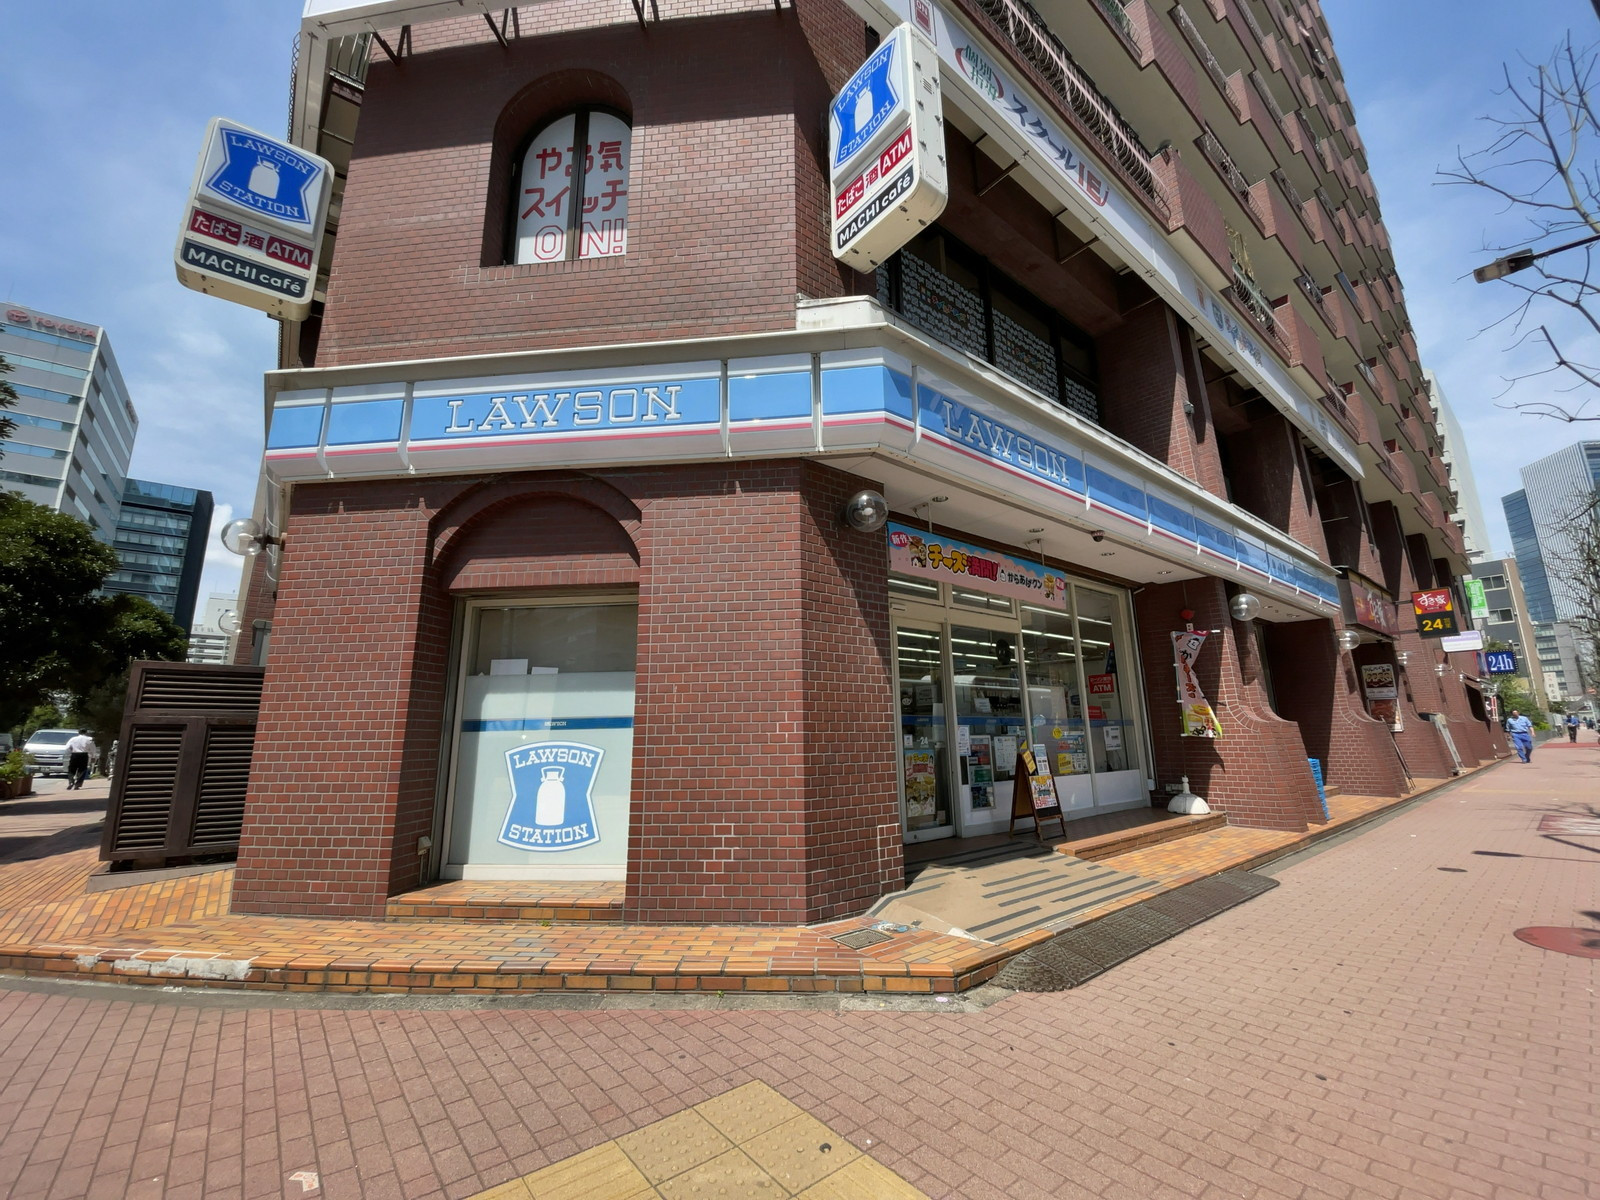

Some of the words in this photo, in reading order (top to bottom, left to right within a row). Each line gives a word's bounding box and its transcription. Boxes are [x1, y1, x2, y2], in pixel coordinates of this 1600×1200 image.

[838, 50, 889, 112] LAWSON
[840, 100, 891, 159] STATION
[231, 135, 310, 175] LAWSON
[837, 183, 863, 212] たばこ
[866, 167, 879, 187] 酒
[881, 134, 911, 173] ATM
[219, 180, 300, 217] STATION
[522, 180, 627, 220] スイッチ
[839, 202, 880, 247] MACHI
[882, 173, 911, 206] café
[194, 215, 239, 241] たばこ
[242, 231, 265, 249] 酒
[268, 241, 309, 265] ATM
[188, 248, 256, 279] MACHI
[259, 272, 301, 294] café
[445, 385, 682, 433] LAWSON
[943, 400, 1070, 485] LAWSON
[1007, 571, 1043, 589] からあげクン
[1417, 593, 1447, 607] すき家
[1422, 618, 1444, 631] 24
[1488, 653, 1514, 671] 24h
[1093, 684, 1112, 693] ATM
[514, 748, 594, 769] LAWSON
[508, 824, 589, 844] STATION
